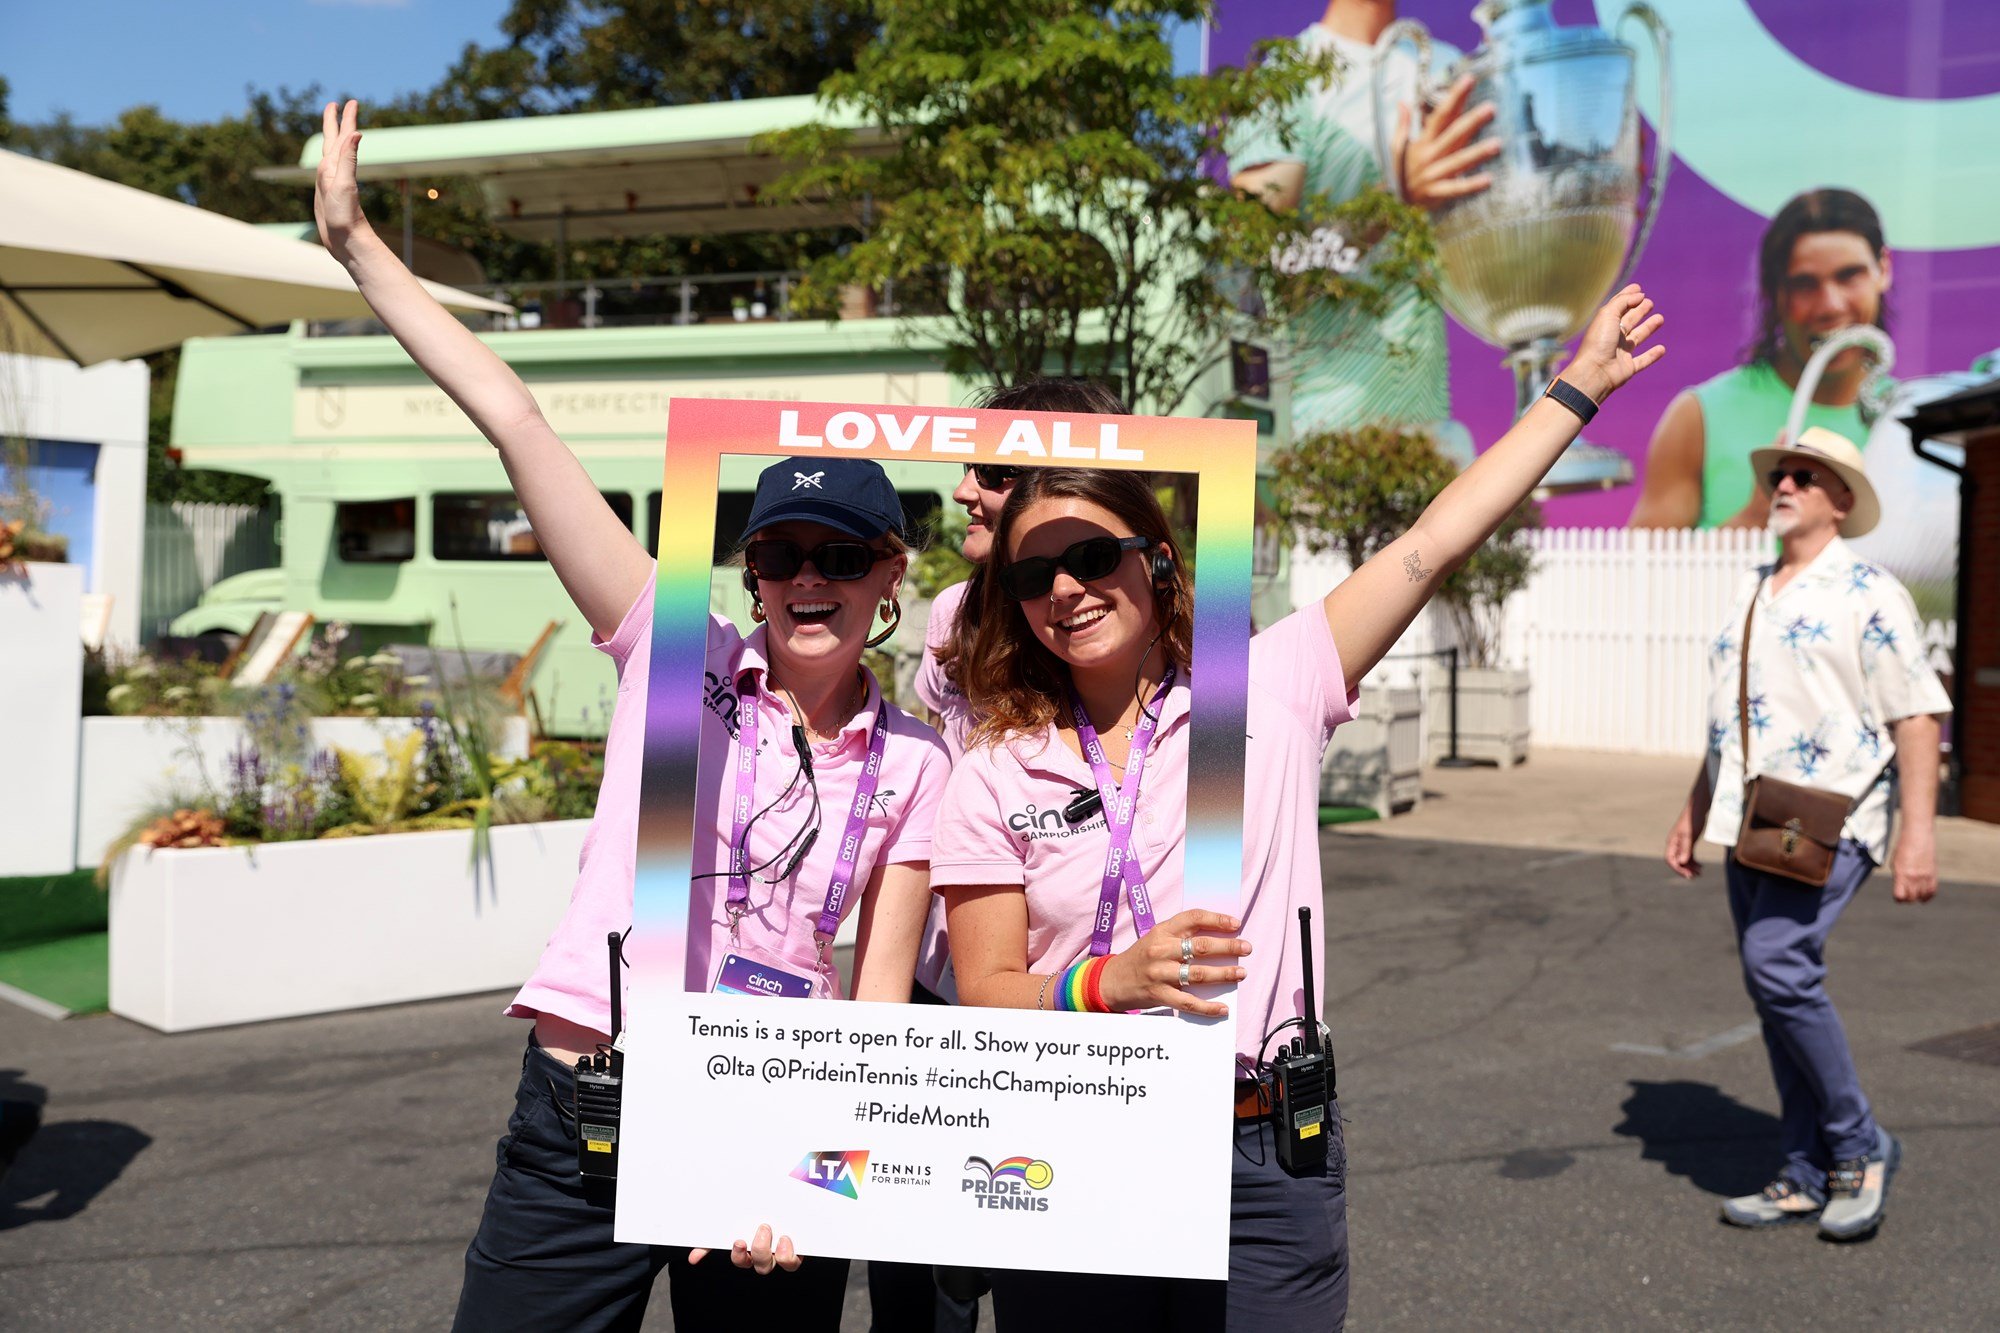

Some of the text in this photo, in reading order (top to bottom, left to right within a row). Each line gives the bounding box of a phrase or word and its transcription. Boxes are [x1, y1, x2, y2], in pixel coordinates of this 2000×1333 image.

[779, 410, 1144, 461] LOVE ALL
[739, 795, 749, 824] cinch
[854, 792, 867, 818] cinch
[1008, 804, 1063, 831] cin
[1119, 796, 1132, 825] cinch
[842, 835, 855, 862] cinch
[1110, 847, 1123, 878] cinch
[828, 881, 843, 912] cinch
[1131, 884, 1146, 915] cinch
[1100, 902, 1113, 933] cinch
[748, 973, 783, 994] cinch
[689, 1015, 1170, 1066] Tennis is a sport open for all. Show your support.
[707, 1055, 1147, 1105] @lta @PrideinTennis #cinchChampionships
[854, 1102, 990, 1129] #PrideMonth
[808, 1158, 861, 1188] LTA
[871, 1163, 931, 1176] TENNIS
[871, 1176, 931, 1186] FOR BRITAIN
[961, 1178, 1021, 1195] PRIDE
[975, 1194, 1049, 1212] TENNIS
